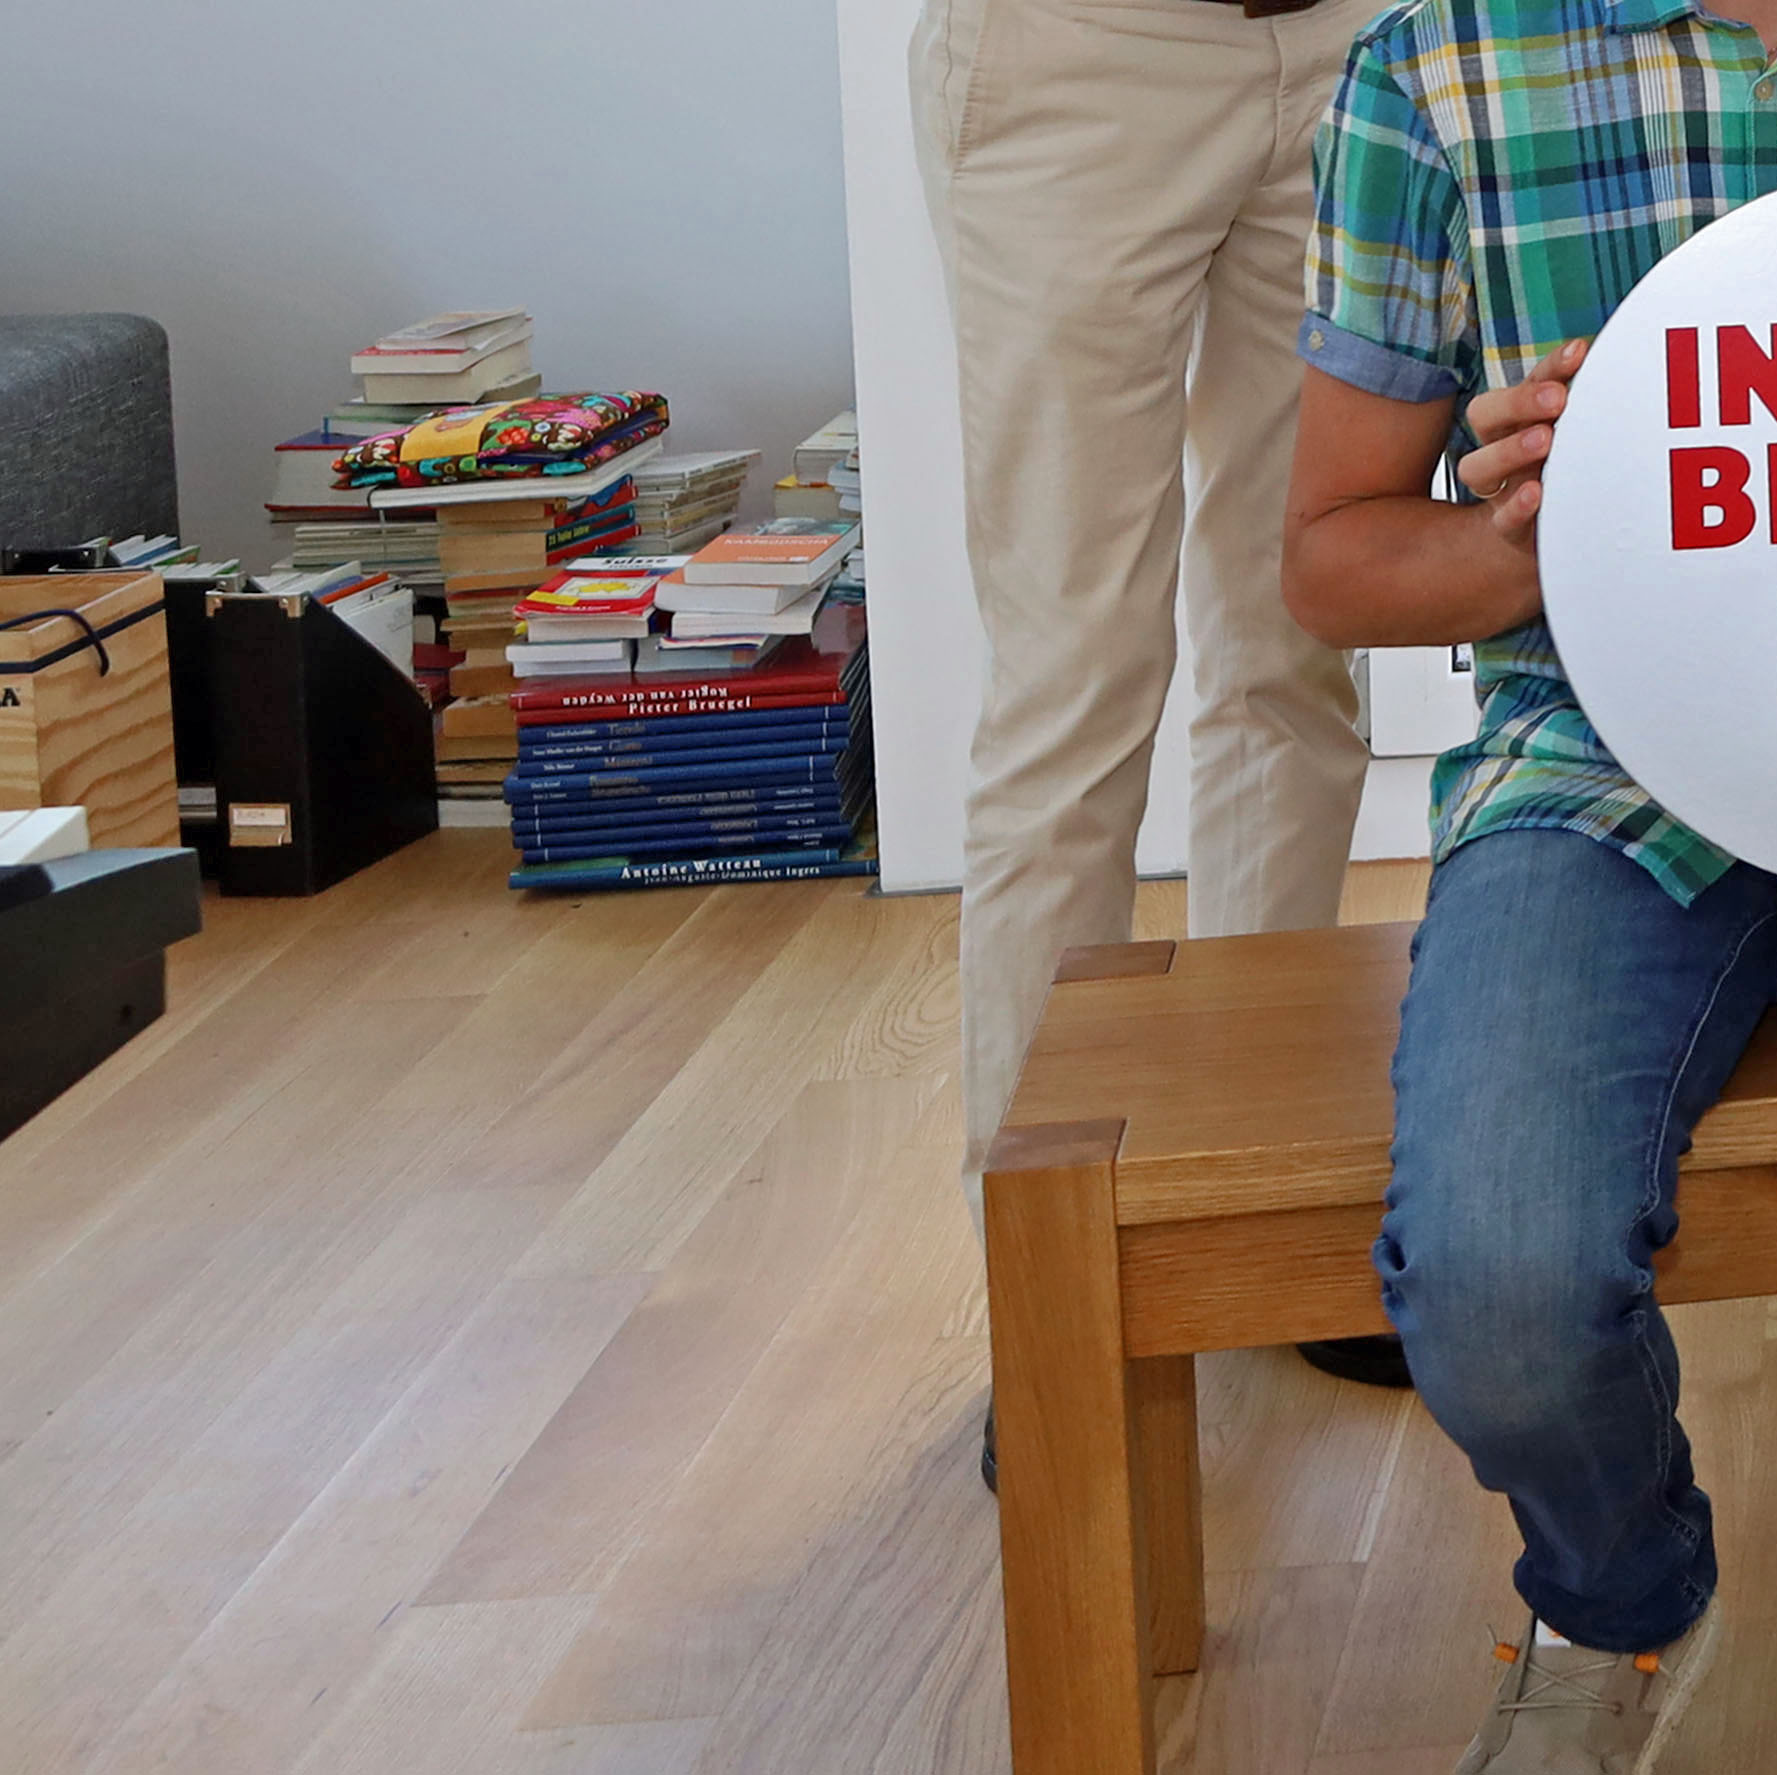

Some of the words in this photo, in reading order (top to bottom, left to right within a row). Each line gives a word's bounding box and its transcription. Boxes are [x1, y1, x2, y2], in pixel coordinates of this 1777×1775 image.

[651, 690, 675, 701] van
[629, 702, 679, 714] Pieter
[689, 697, 751, 712] Bruegel
[621, 864, 688, 879] Antoine
[693, 858, 762, 873] Watteau
